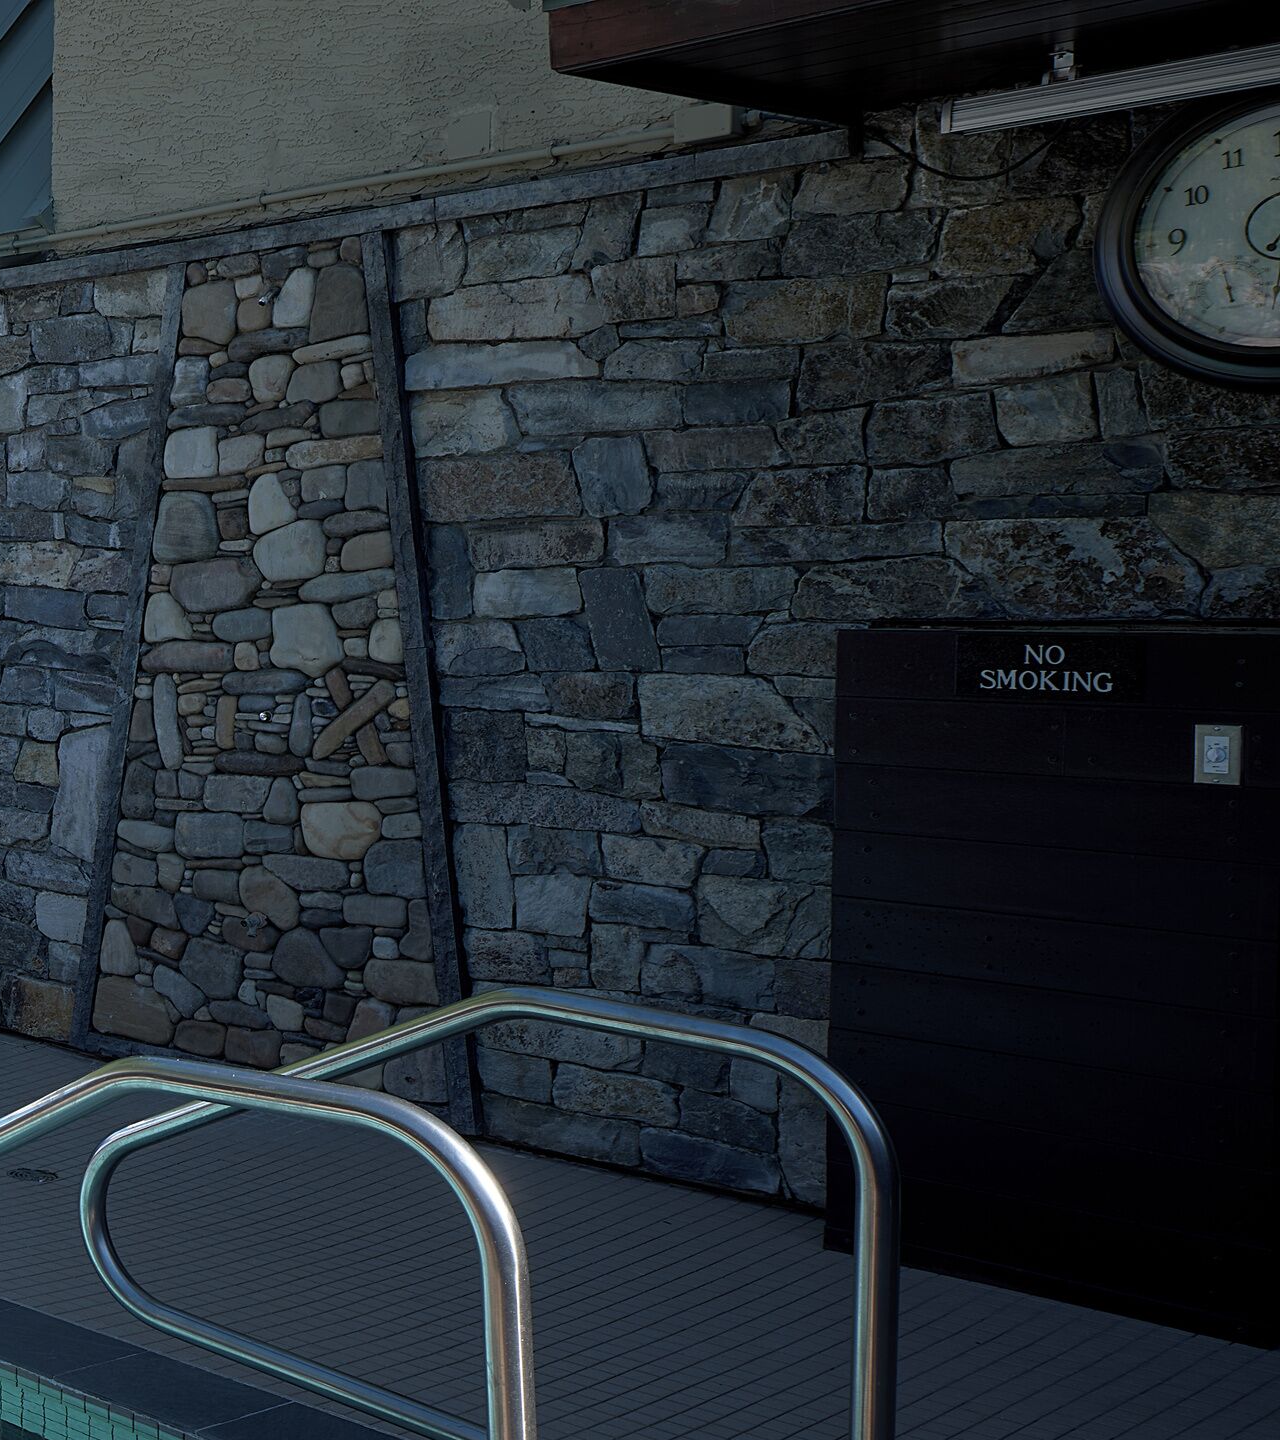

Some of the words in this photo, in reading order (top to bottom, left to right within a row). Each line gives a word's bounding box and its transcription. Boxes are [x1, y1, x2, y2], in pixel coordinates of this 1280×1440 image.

[1221, 148, 1245, 170] 11
[1184, 185, 1209, 207] 10
[1167, 228, 1187, 257] 9
[1023, 644, 1066, 666] NO
[979, 668, 1114, 694] SMOKING
